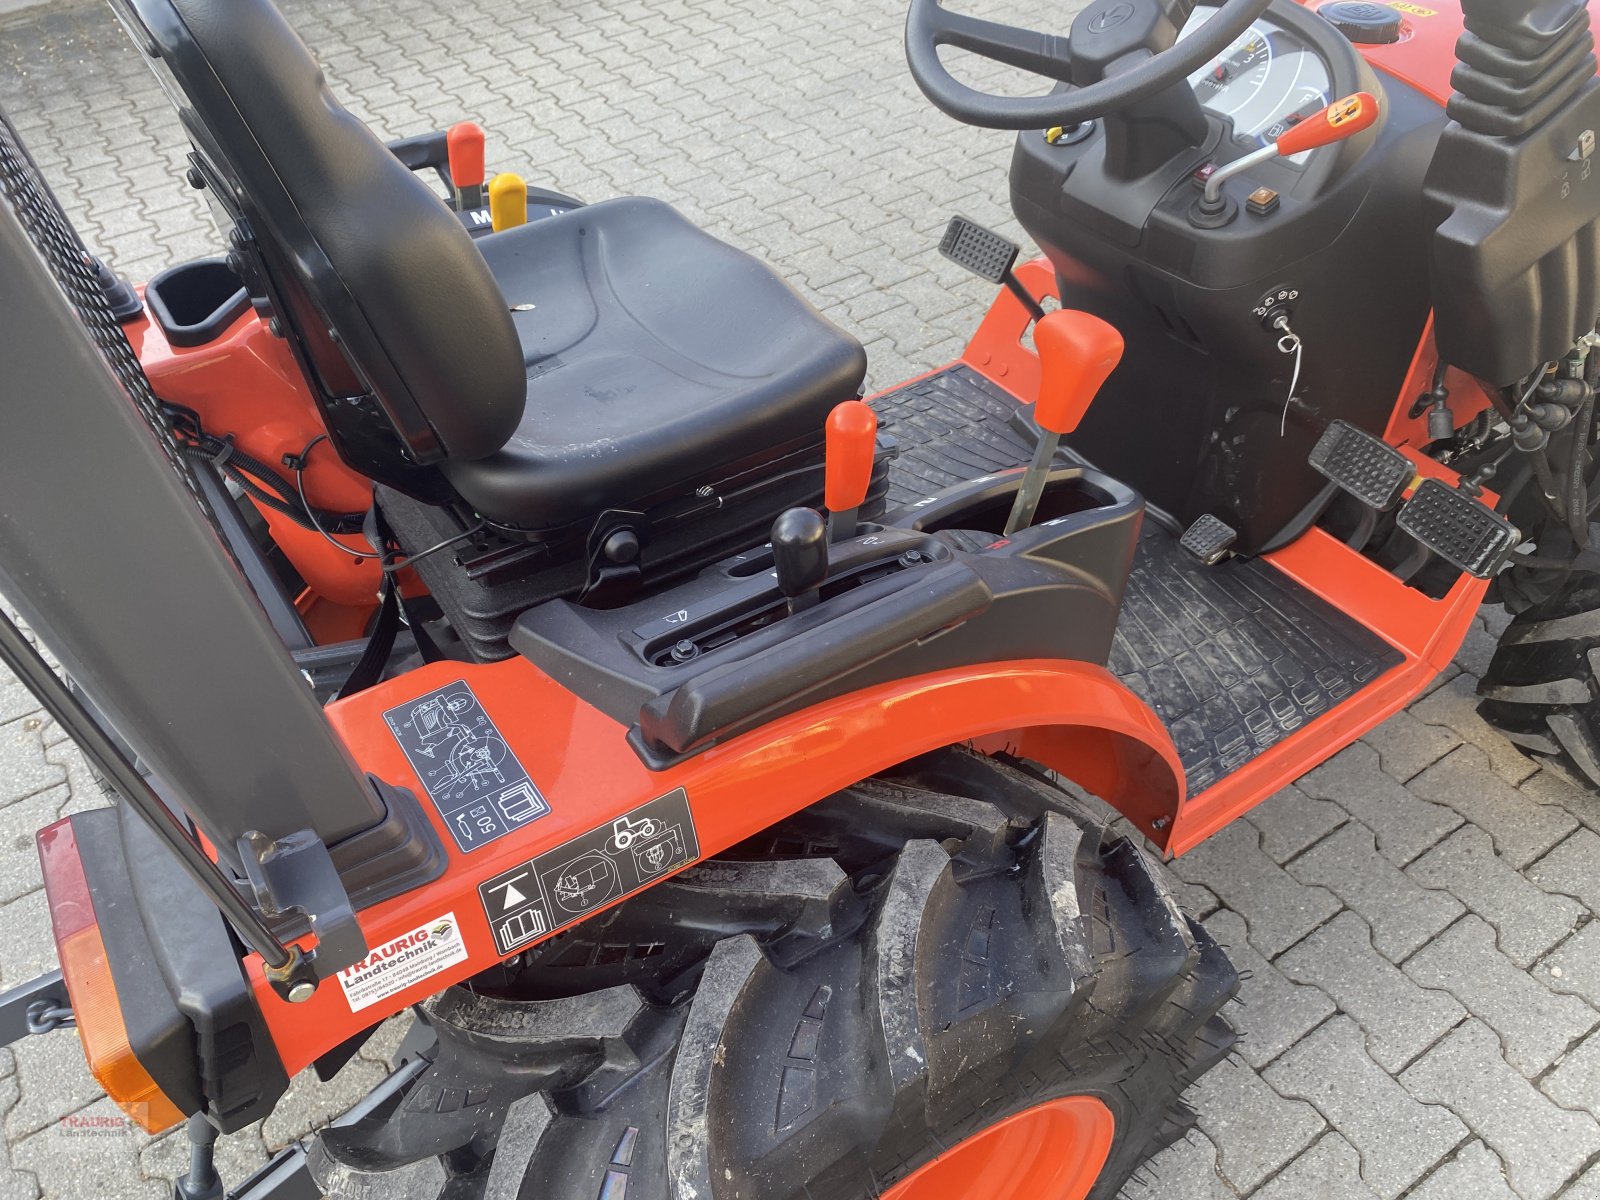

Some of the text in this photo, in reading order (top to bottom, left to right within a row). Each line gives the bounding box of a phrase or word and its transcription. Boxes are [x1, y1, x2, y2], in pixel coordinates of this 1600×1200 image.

[1243, 54, 1254, 64] 3
[1299, 93, 1312, 104] F
[470, 209, 492, 225] M
[476, 816, 496, 834] 50
[344, 939, 438, 989] Landtechnik
